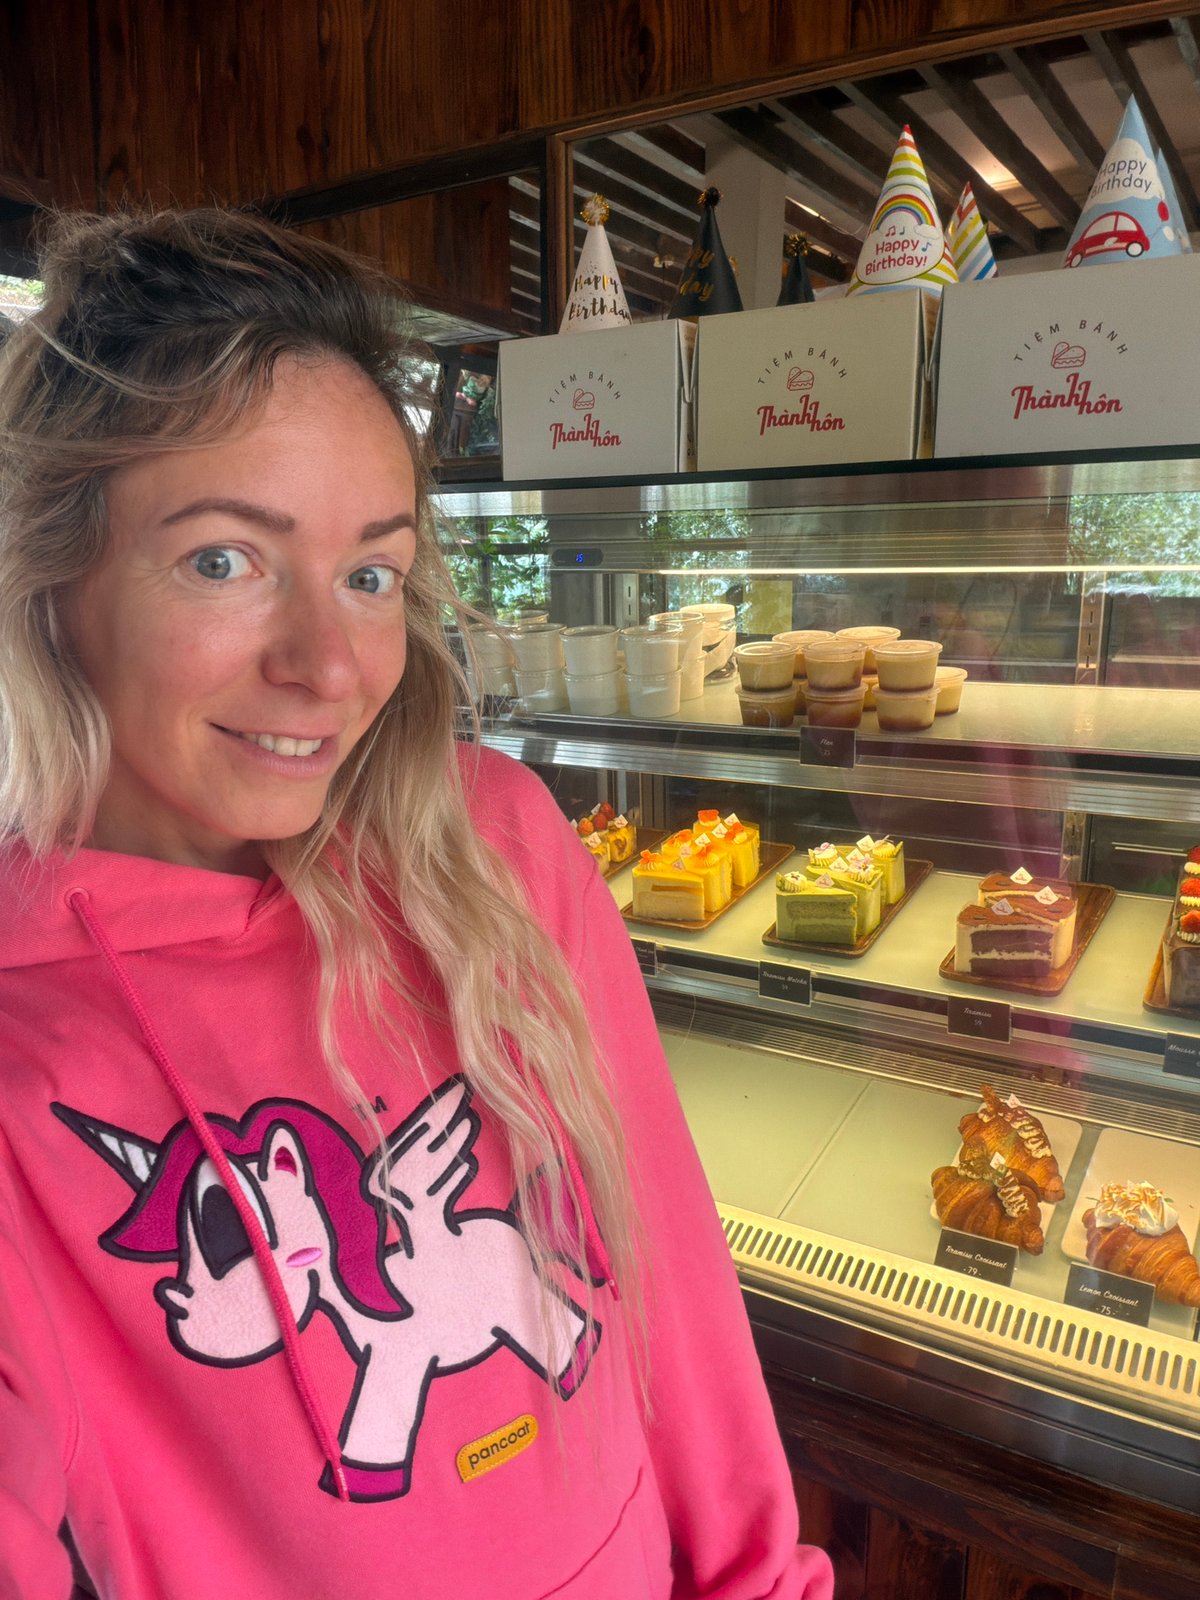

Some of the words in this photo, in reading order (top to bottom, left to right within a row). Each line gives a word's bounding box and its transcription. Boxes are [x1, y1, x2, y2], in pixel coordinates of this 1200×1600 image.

[875, 239, 920, 256] Happy
[865, 253, 928, 276] Birthday!
[574, 273, 619, 295] Happy
[945, 1245, 973, 1260] Tiramisu
[974, 1253, 1008, 1269] Croissant
[1079, 1284, 1102, 1297] Lemon
[1103, 1290, 1139, 1306] Croissant
[468, 1421, 530, 1470] pancoat
